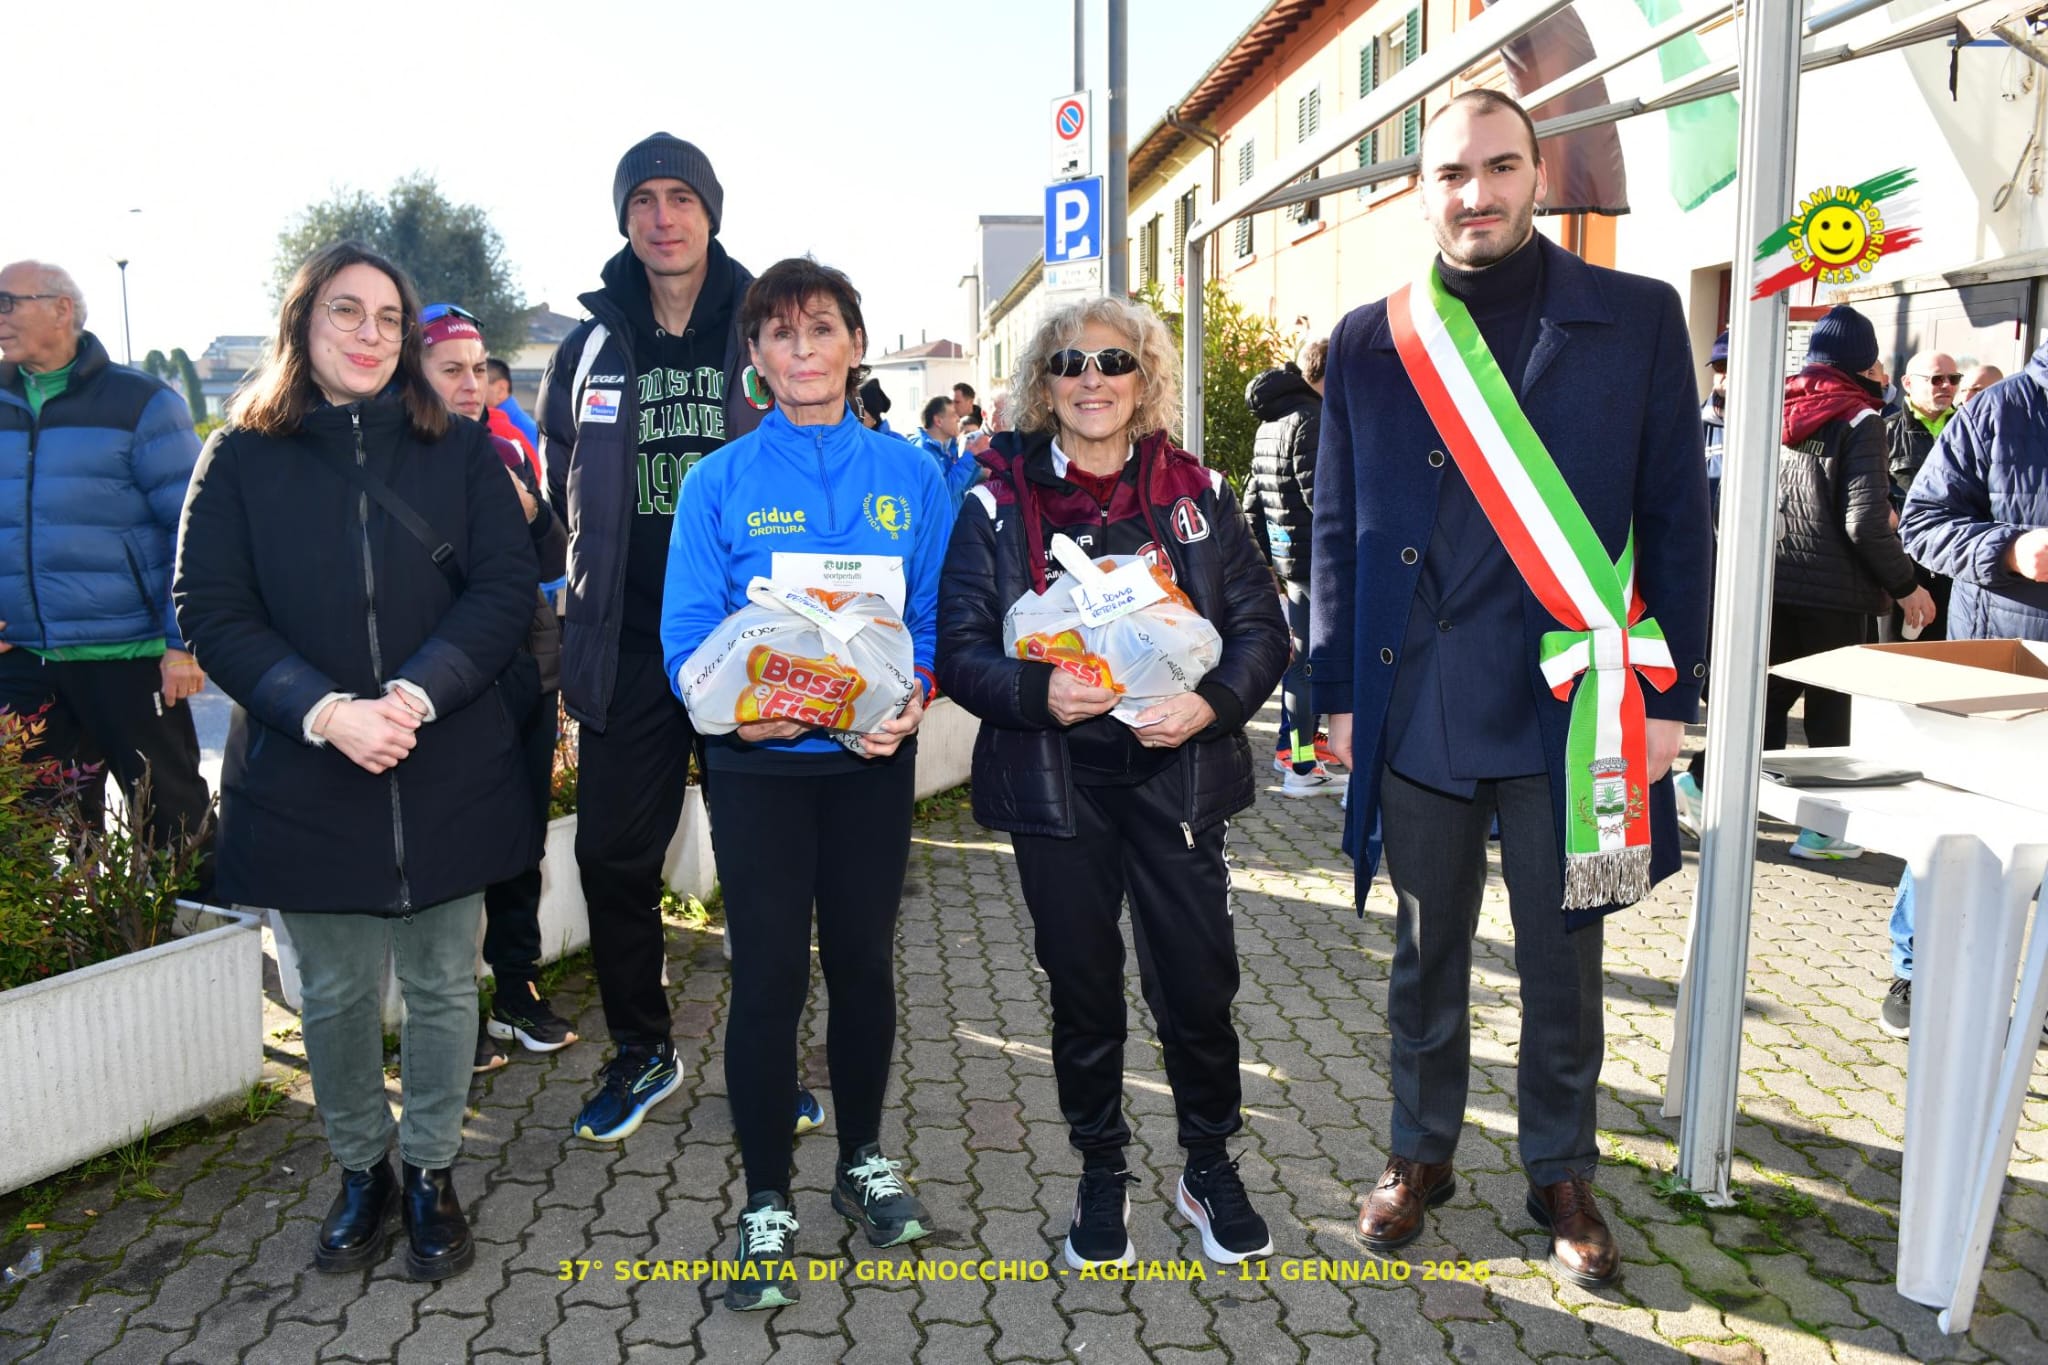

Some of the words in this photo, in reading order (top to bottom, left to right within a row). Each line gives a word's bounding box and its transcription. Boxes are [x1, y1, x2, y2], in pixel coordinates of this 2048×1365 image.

[1055, 189, 1090, 256] P
[586, 375, 625, 384] LEGEA
[746, 507, 807, 528] Gidue
[749, 524, 807, 537] ORDITURA
[835, 561, 862, 570] UISP
[761, 653, 857, 705] Bassi
[753, 683, 770, 702] e
[761, 690, 848, 726] Fissi
